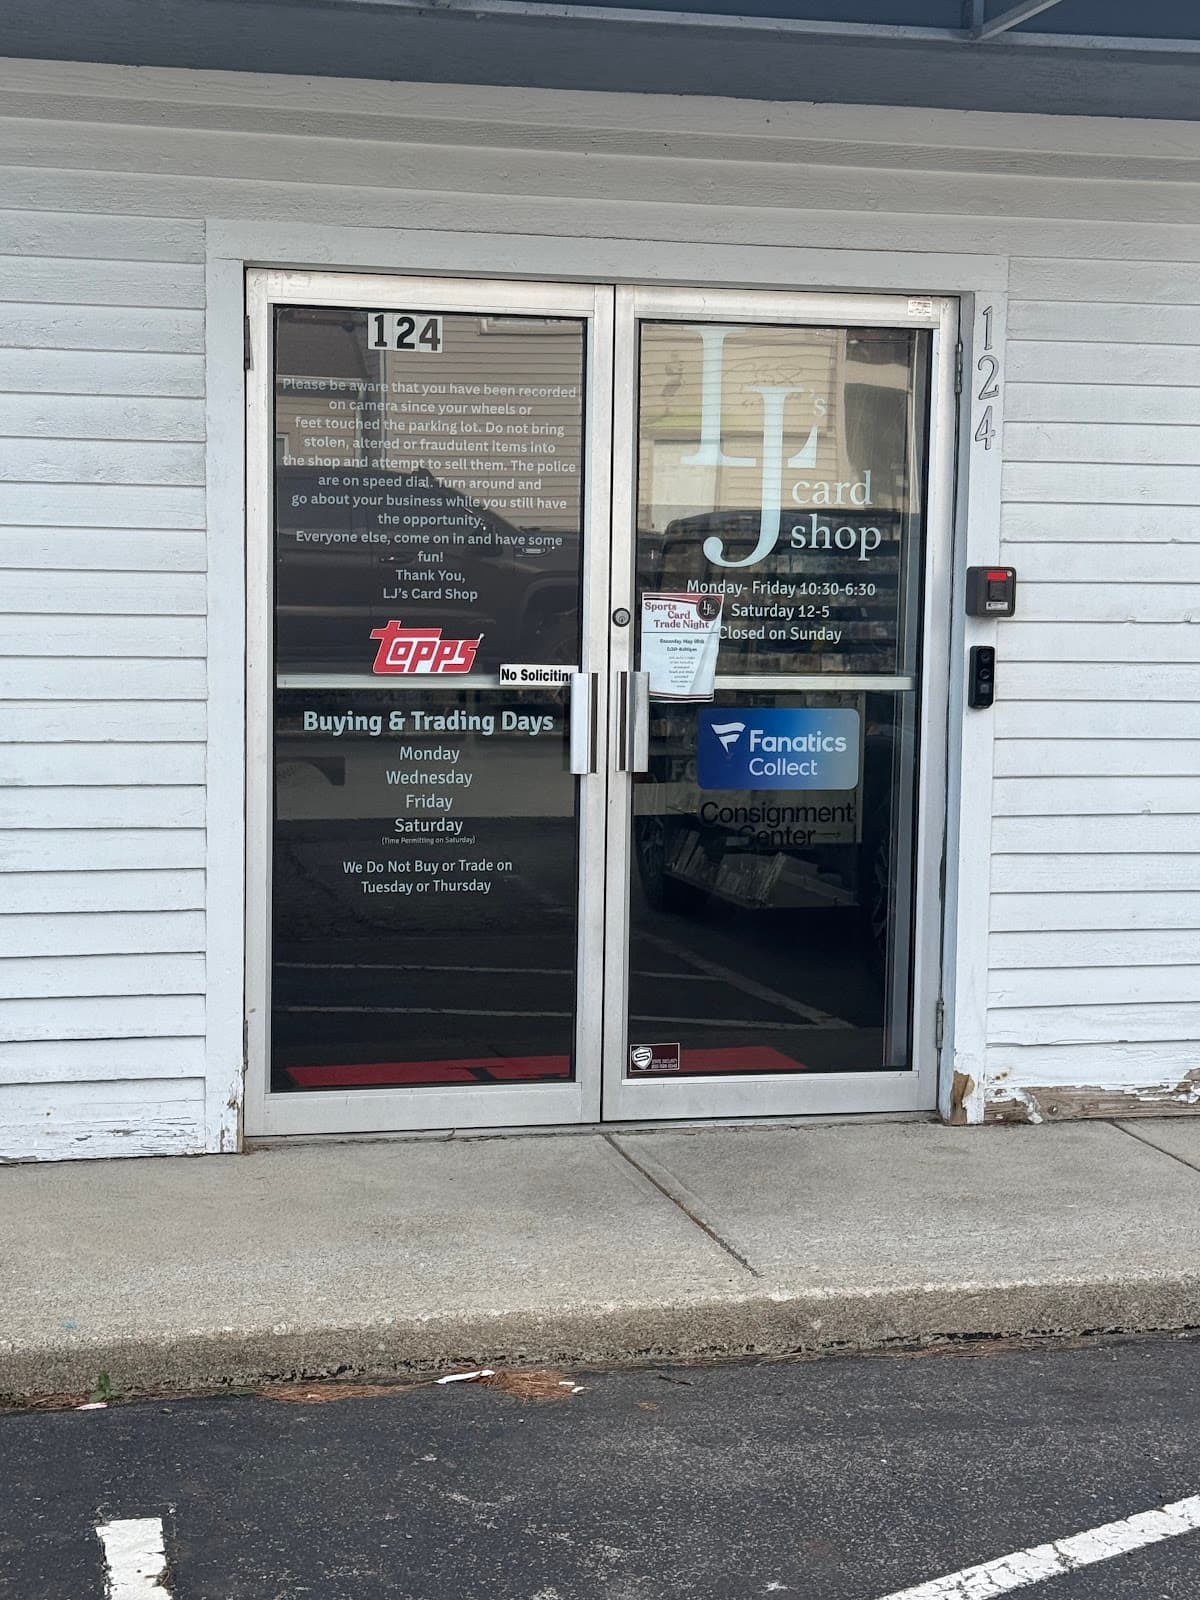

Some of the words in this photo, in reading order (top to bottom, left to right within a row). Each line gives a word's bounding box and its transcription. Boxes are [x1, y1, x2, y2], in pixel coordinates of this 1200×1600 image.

[374, 314, 441, 352] 124
[974, 306, 1000, 450] 124
[282, 378, 326, 391] Please
[330, 378, 346, 392] be
[350, 382, 388, 393] aware
[392, 381, 420, 394] that
[422, 384, 447, 396] you
[449, 383, 481, 396] have
[484, 384, 516, 396] been
[518, 384, 576, 398] recorded
[328, 401, 346, 410] on
[350, 402, 398, 412] camera
[400, 400, 435, 413] since
[438, 404, 468, 416] your
[471, 402, 516, 416] wheels
[518, 406, 532, 416] or
[295, 416, 324, 429] feet
[326, 418, 380, 430] touched
[383, 419, 406, 430] the
[408, 420, 457, 434] parking
[460, 421, 482, 434] lot.
[486, 422, 504, 434] Do
[506, 423, 529, 434] not
[532, 422, 564, 438] bring
[304, 436, 349, 450] stolen,
[352, 436, 399, 450] altered
[403, 440, 418, 450] or
[420, 438, 489, 452] fraudulent
[492, 440, 528, 453] items
[530, 442, 556, 454] into
[282, 454, 304, 467] the
[308, 456, 341, 470] shop
[344, 456, 368, 468] and
[372, 456, 426, 472] attempt
[429, 458, 442, 470] to
[444, 457, 468, 470] sell
[470, 458, 508, 472] them.
[510, 459, 534, 472] The
[537, 460, 576, 474] police
[318, 476, 340, 486] are
[342, 477, 360, 486] on
[362, 475, 402, 490] speed
[405, 475, 434, 488] dial.
[437, 477, 466, 489] Turn
[469, 477, 514, 490] around
[518, 478, 542, 490] and
[792, 470, 872, 505] card
[292, 495, 308, 506] go
[310, 494, 350, 506] about
[352, 497, 382, 508] your
[386, 495, 443, 507] business
[446, 496, 480, 508] while
[483, 498, 507, 510] you
[510, 496, 534, 509] still
[536, 498, 568, 510] have
[378, 512, 400, 525] the
[403, 513, 484, 528] opportunity.
[296, 530, 358, 545] Everyone
[361, 532, 392, 545] else,
[394, 534, 430, 544] come
[432, 534, 450, 544] on
[452, 532, 465, 545] in
[468, 532, 492, 545] and
[496, 534, 526, 546] have
[528, 536, 562, 546] some
[790, 514, 881, 562] shop
[417, 550, 444, 563] fun!
[396, 568, 434, 582] Thank
[437, 570, 466, 584] You,
[383, 588, 408, 600] LJ's
[411, 588, 442, 600] Card
[444, 588, 478, 602] Shop
[686, 580, 748, 596] Monday-
[752, 580, 796, 598] Friday
[800, 582, 876, 596] 10:30-6:30
[644, 602, 676, 612] Sports
[668, 610, 690, 620] Card
[731, 604, 794, 621] Saturday
[798, 604, 830, 618] 12-5
[654, 620, 681, 628] Trade
[682, 620, 710, 630] Night
[719, 626, 765, 641] Closed
[769, 628, 786, 641] on
[789, 627, 842, 644] Sunday
[502, 668, 517, 680] No
[303, 711, 382, 736] Buying
[388, 711, 406, 730] &
[411, 710, 495, 736] Trading
[502, 710, 554, 736] Days
[750, 730, 846, 752] Fanatics
[400, 746, 460, 764] Monday
[750, 758, 818, 776] Collect
[386, 770, 473, 788] Wednesday
[406, 794, 453, 812] Friday
[700, 802, 854, 828] Consignment
[394, 818, 464, 836] Saturday
[740, 825, 817, 846] Center
[382, 836, 400, 845] (Time
[400, 836, 434, 846] Permitting
[445, 836, 476, 845] Saturday)
[342, 860, 362, 874] We
[366, 860, 384, 874] Do
[388, 860, 411, 873] Not
[414, 860, 440, 876] Buy
[442, 862, 455, 872] or
[458, 859, 494, 872] Trade
[496, 861, 512, 871] on
[361, 880, 413, 895] Tuesday
[416, 882, 430, 892] or
[432, 879, 492, 894] Thursday
